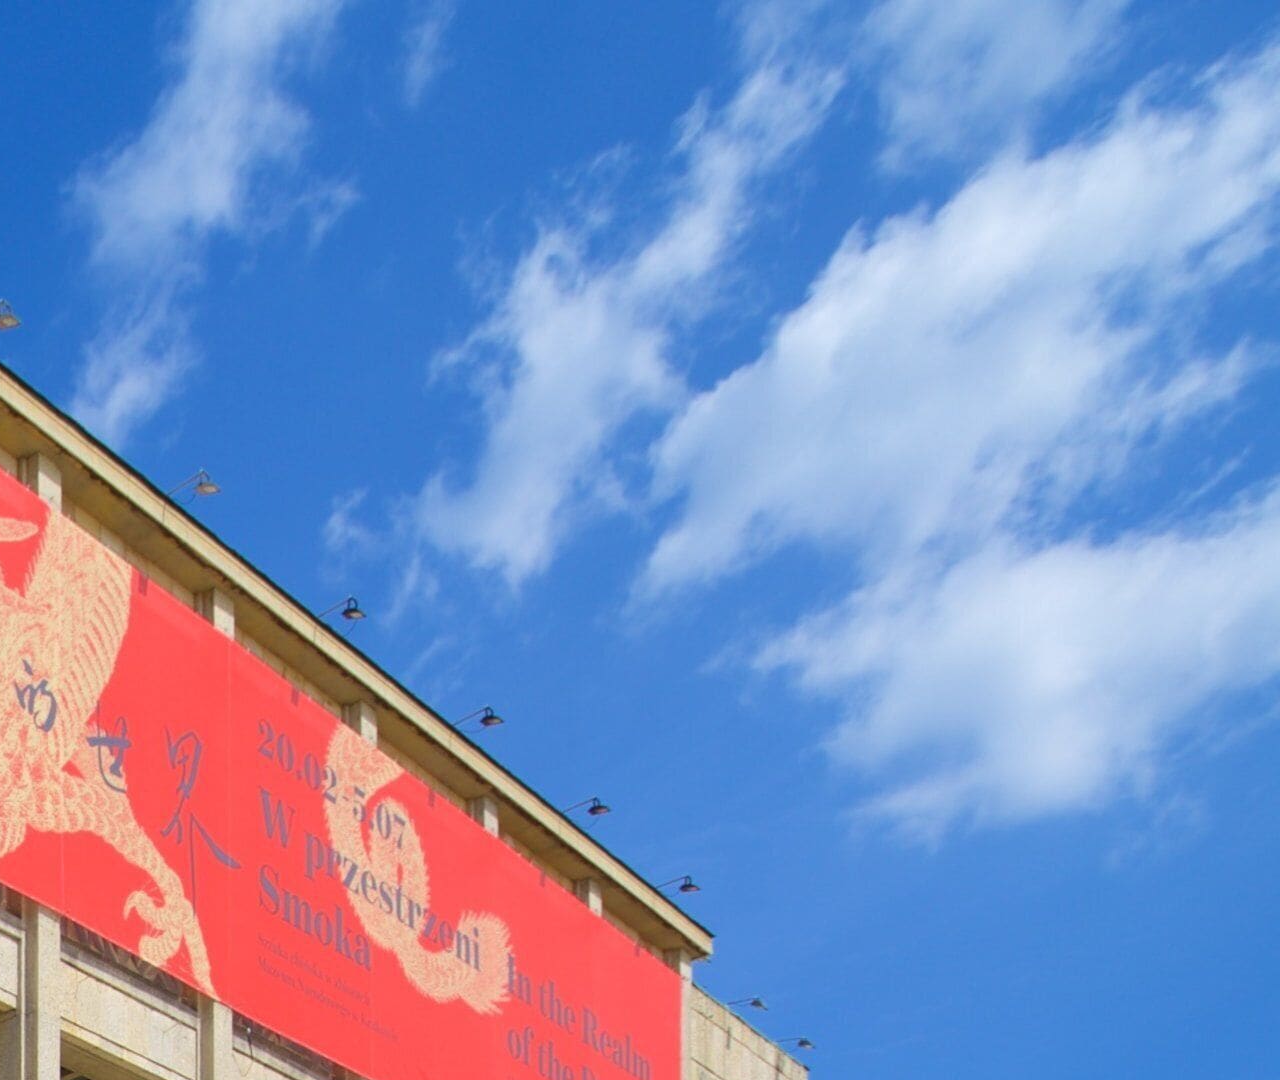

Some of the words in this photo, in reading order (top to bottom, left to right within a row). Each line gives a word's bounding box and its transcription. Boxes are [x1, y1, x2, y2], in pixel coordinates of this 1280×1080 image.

[258, 864, 372, 972] Smoka
[259, 786, 296, 848] W
[305, 832, 481, 972] przestrzeni
[507, 953, 532, 1005] In
[538, 979, 576, 1036] the
[507, 1025, 535, 1066] of
